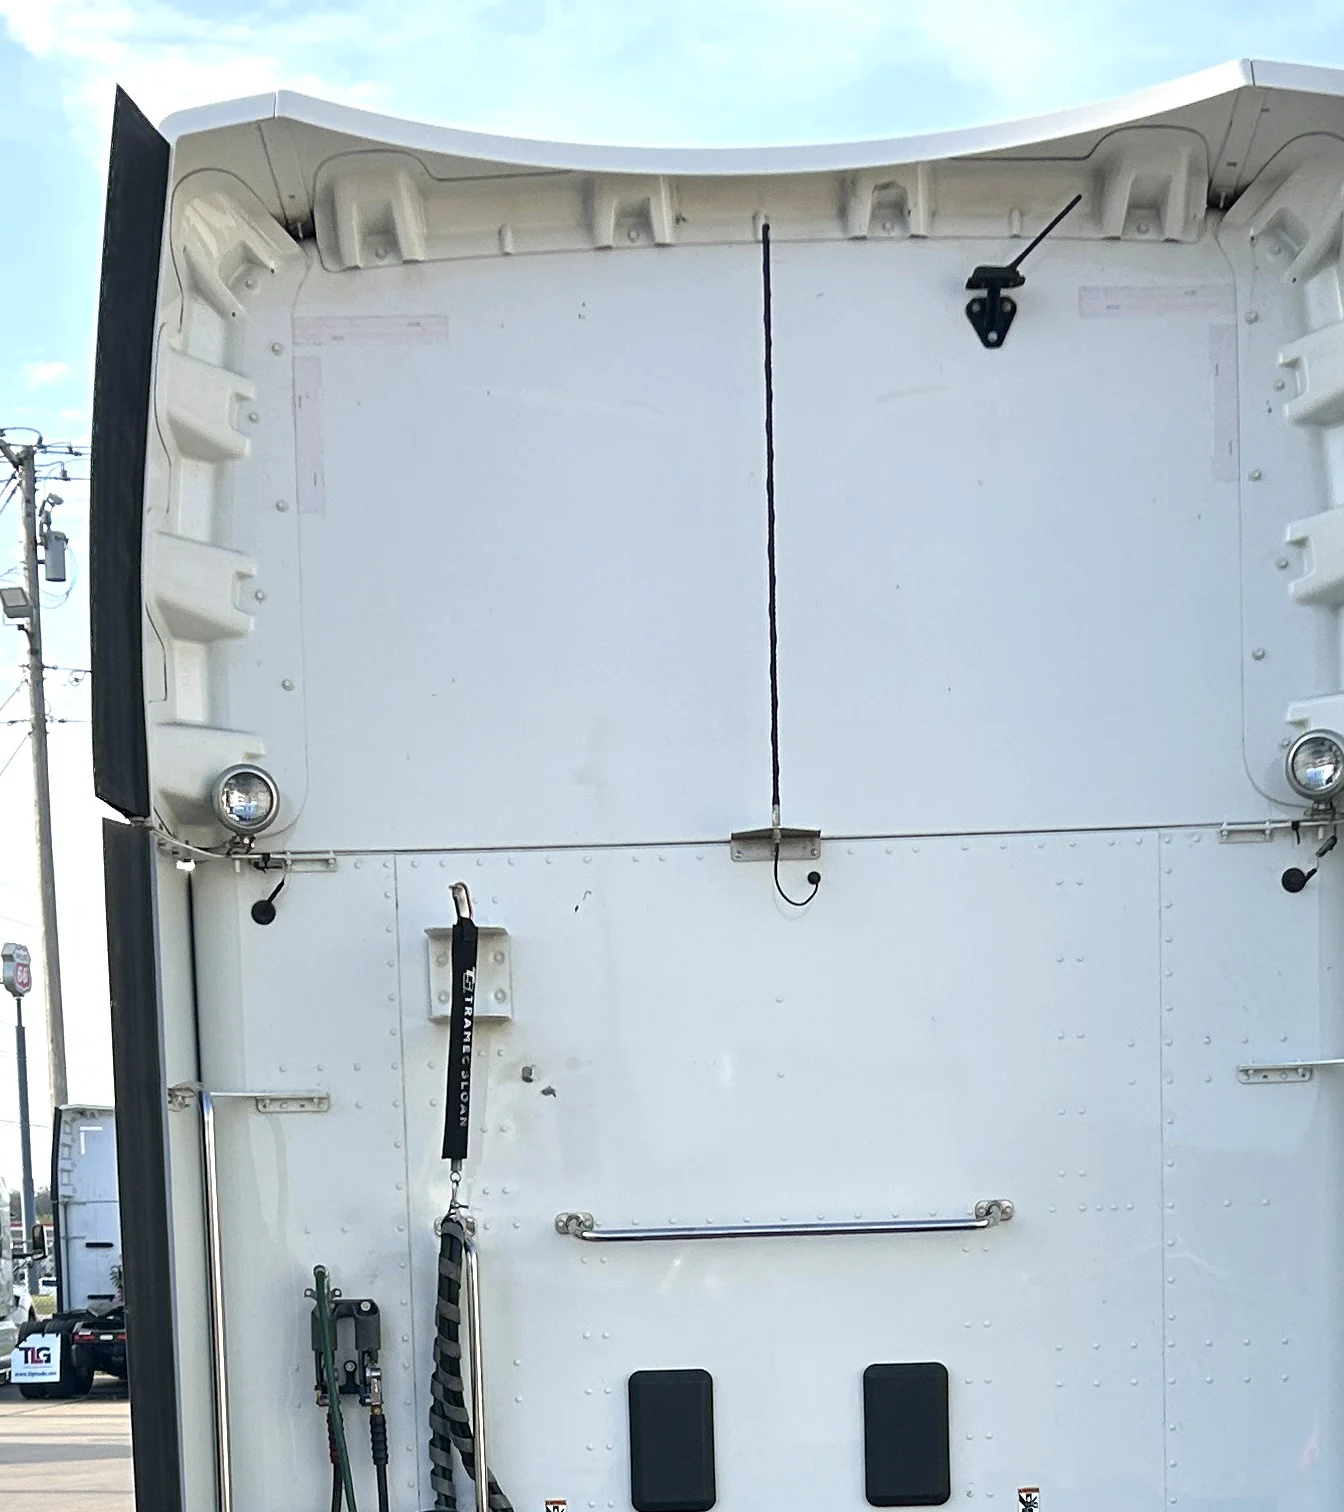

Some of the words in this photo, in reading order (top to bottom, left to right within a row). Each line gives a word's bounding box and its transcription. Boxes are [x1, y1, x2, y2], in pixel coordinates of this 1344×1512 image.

[461, 995, 474, 1066] TRAMEC
[459, 1069, 471, 1127] SLOAN
[18, 1347, 52, 1365] TLG
